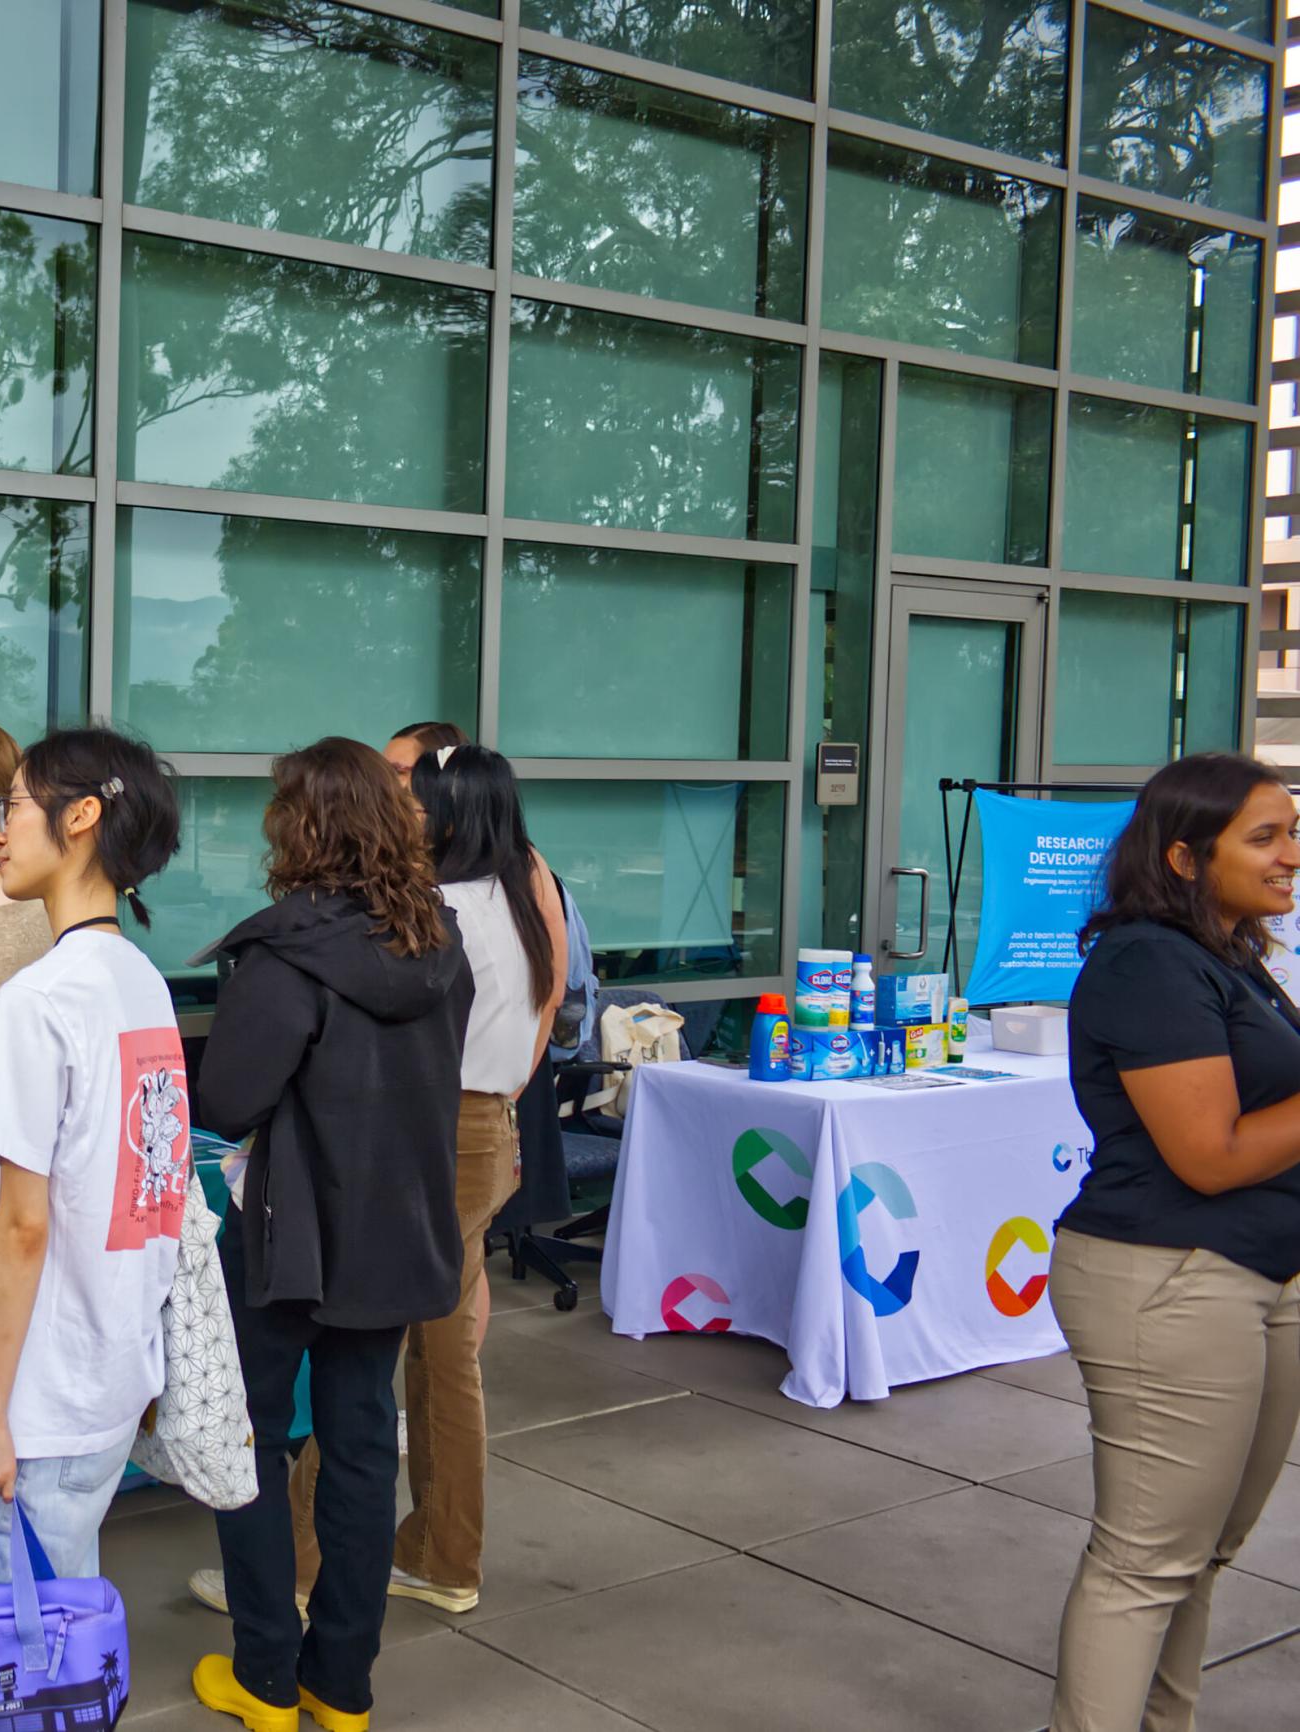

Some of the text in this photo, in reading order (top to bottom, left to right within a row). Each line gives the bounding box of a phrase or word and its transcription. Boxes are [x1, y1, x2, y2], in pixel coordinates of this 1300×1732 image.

[1037, 836, 1104, 849] RESEARCH
[1029, 851, 1103, 865] DEVELOPME
[1008, 942, 1039, 951] process,
[1030, 951, 1046, 960] help
[999, 961, 1045, 969] sustainable
[1077, 1146, 1093, 1164] Th
